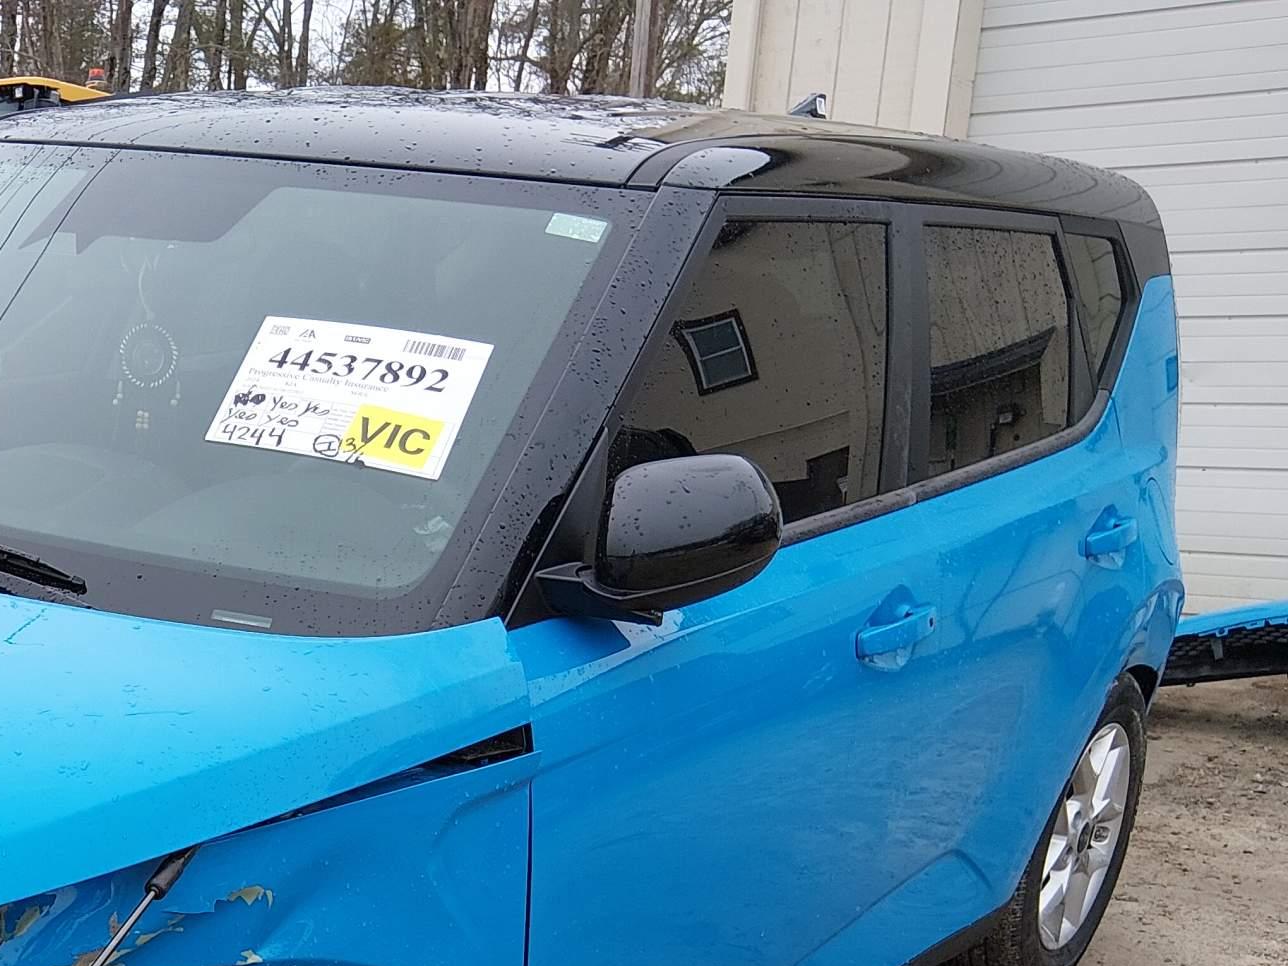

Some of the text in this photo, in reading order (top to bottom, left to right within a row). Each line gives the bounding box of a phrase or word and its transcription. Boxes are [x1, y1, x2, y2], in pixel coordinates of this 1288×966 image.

[248, 367, 301, 381] Progressive
[302, 374, 343, 386] Casualty
[344, 380, 389, 393] Insurance
[268, 347, 449, 393] 44537892
[222, 423, 286, 447] 4244
[361, 416, 431, 455] VIC
